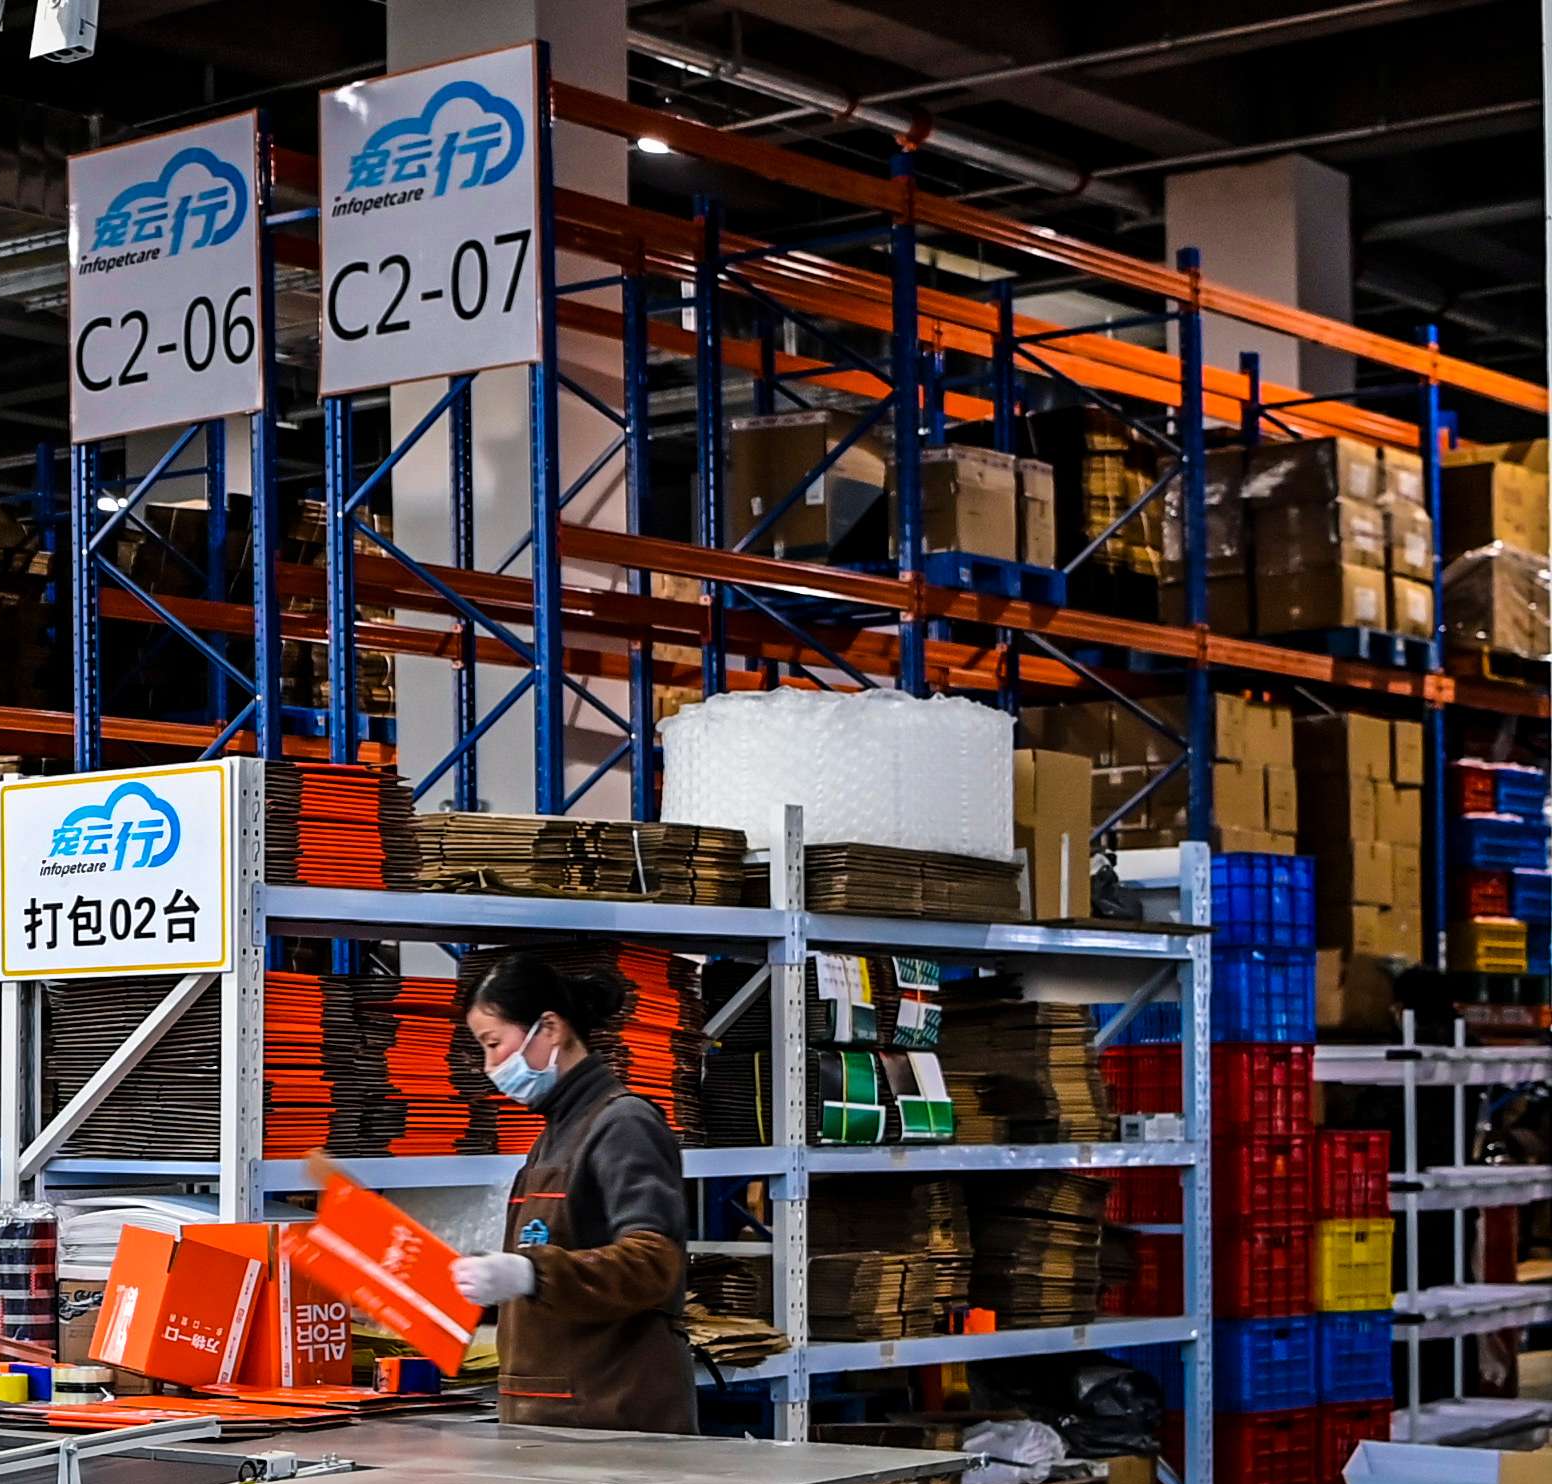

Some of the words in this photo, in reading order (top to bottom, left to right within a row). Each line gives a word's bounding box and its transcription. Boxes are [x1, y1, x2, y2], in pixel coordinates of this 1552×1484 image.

[345, 121, 502, 198] 宠云行
[90, 185, 229, 256] 宠云行
[331, 185, 425, 218] infopetcare
[78, 245, 161, 276] infopetcare
[326, 229, 532, 341] C2-07
[75, 285, 256, 393] C2-06
[48, 818, 165, 872] 宠云行
[39, 860, 107, 878] infopetcare
[23, 889, 201, 950] 打包02台
[296, 1302, 346, 1322] ONE
[297, 1322, 346, 1344] FOR
[297, 1341, 346, 1364] ALL
